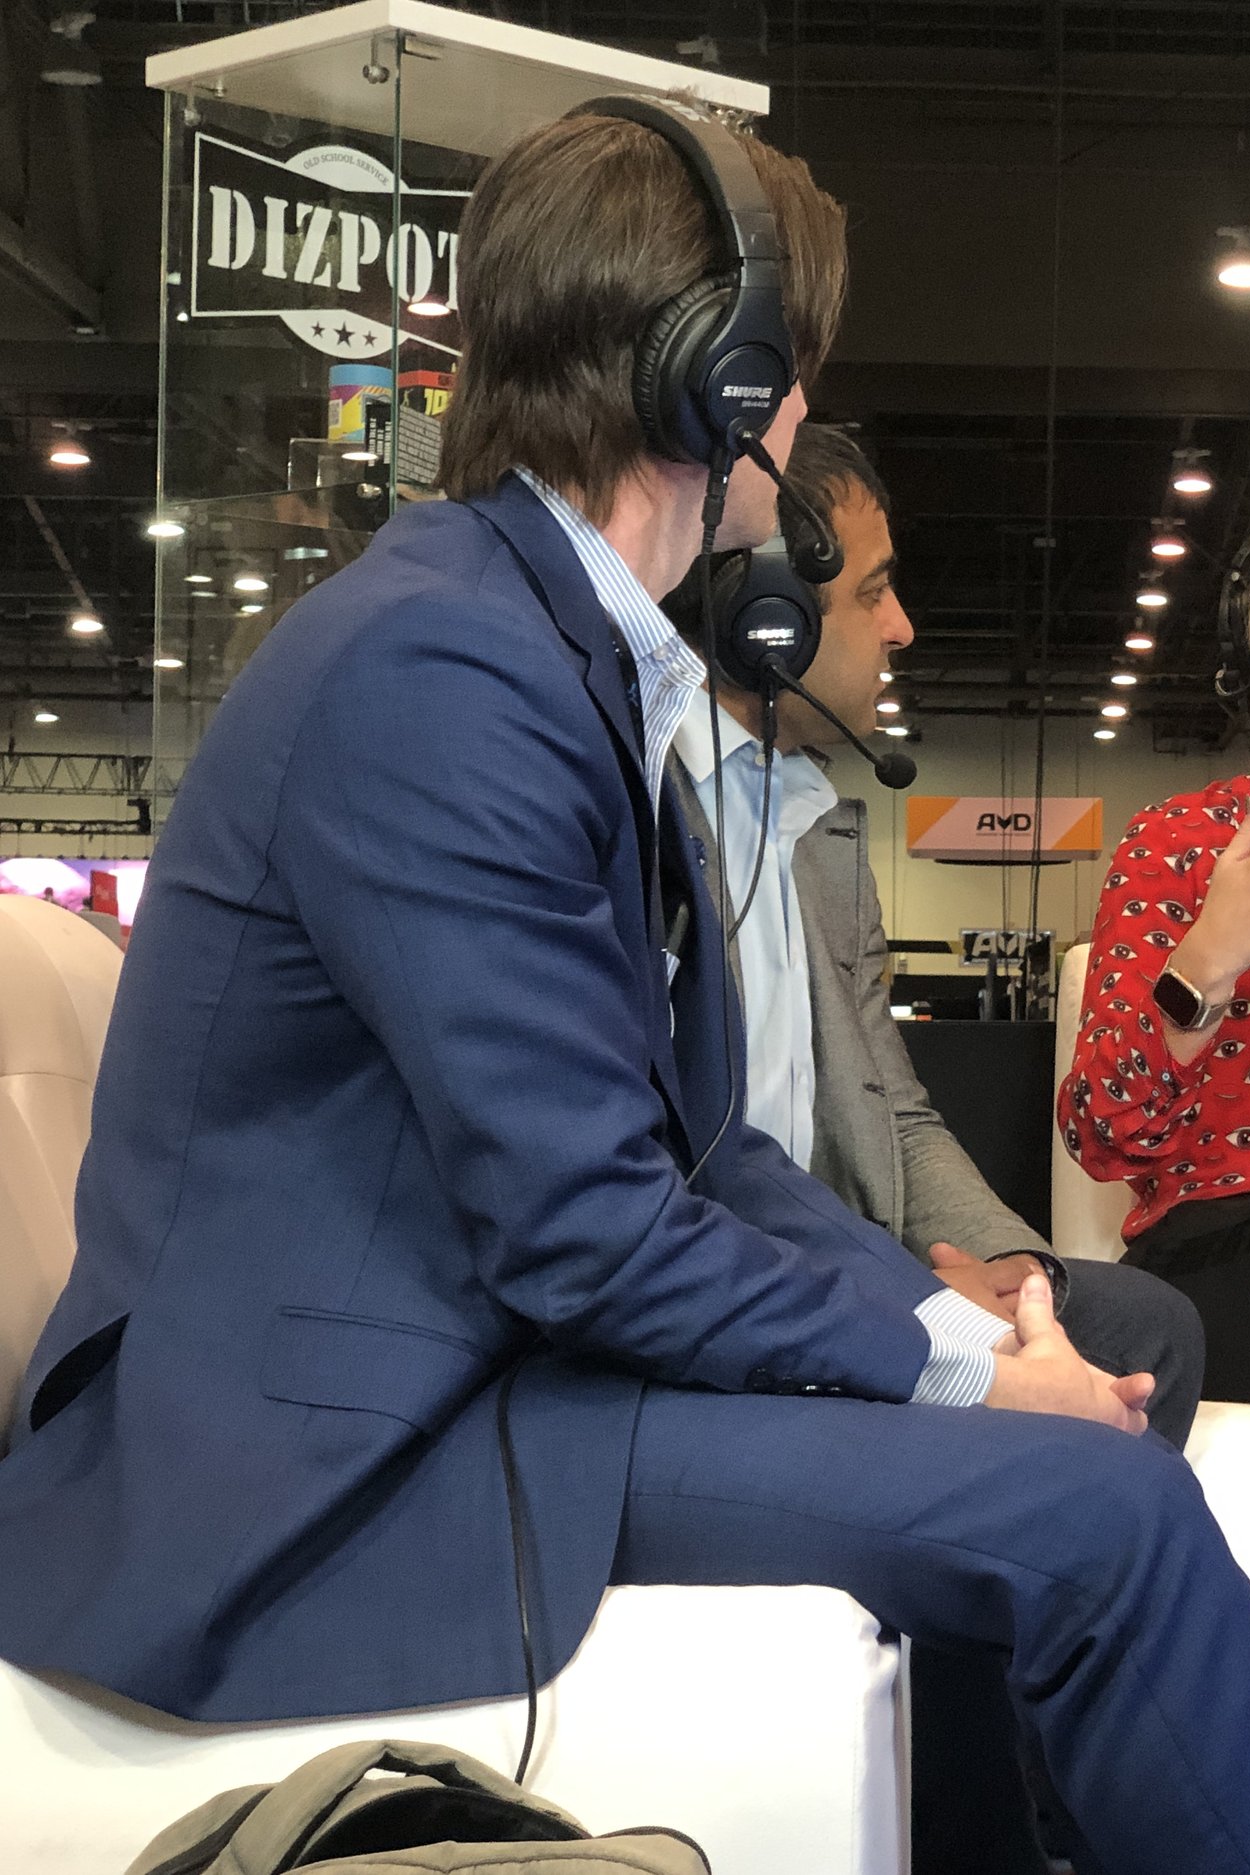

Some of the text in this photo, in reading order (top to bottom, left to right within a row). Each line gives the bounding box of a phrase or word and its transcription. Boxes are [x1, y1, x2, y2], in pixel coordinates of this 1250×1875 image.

[303, 153, 389, 186] OLD SCHOOL SERVICE
[721, 385, 773, 398] SHURE
